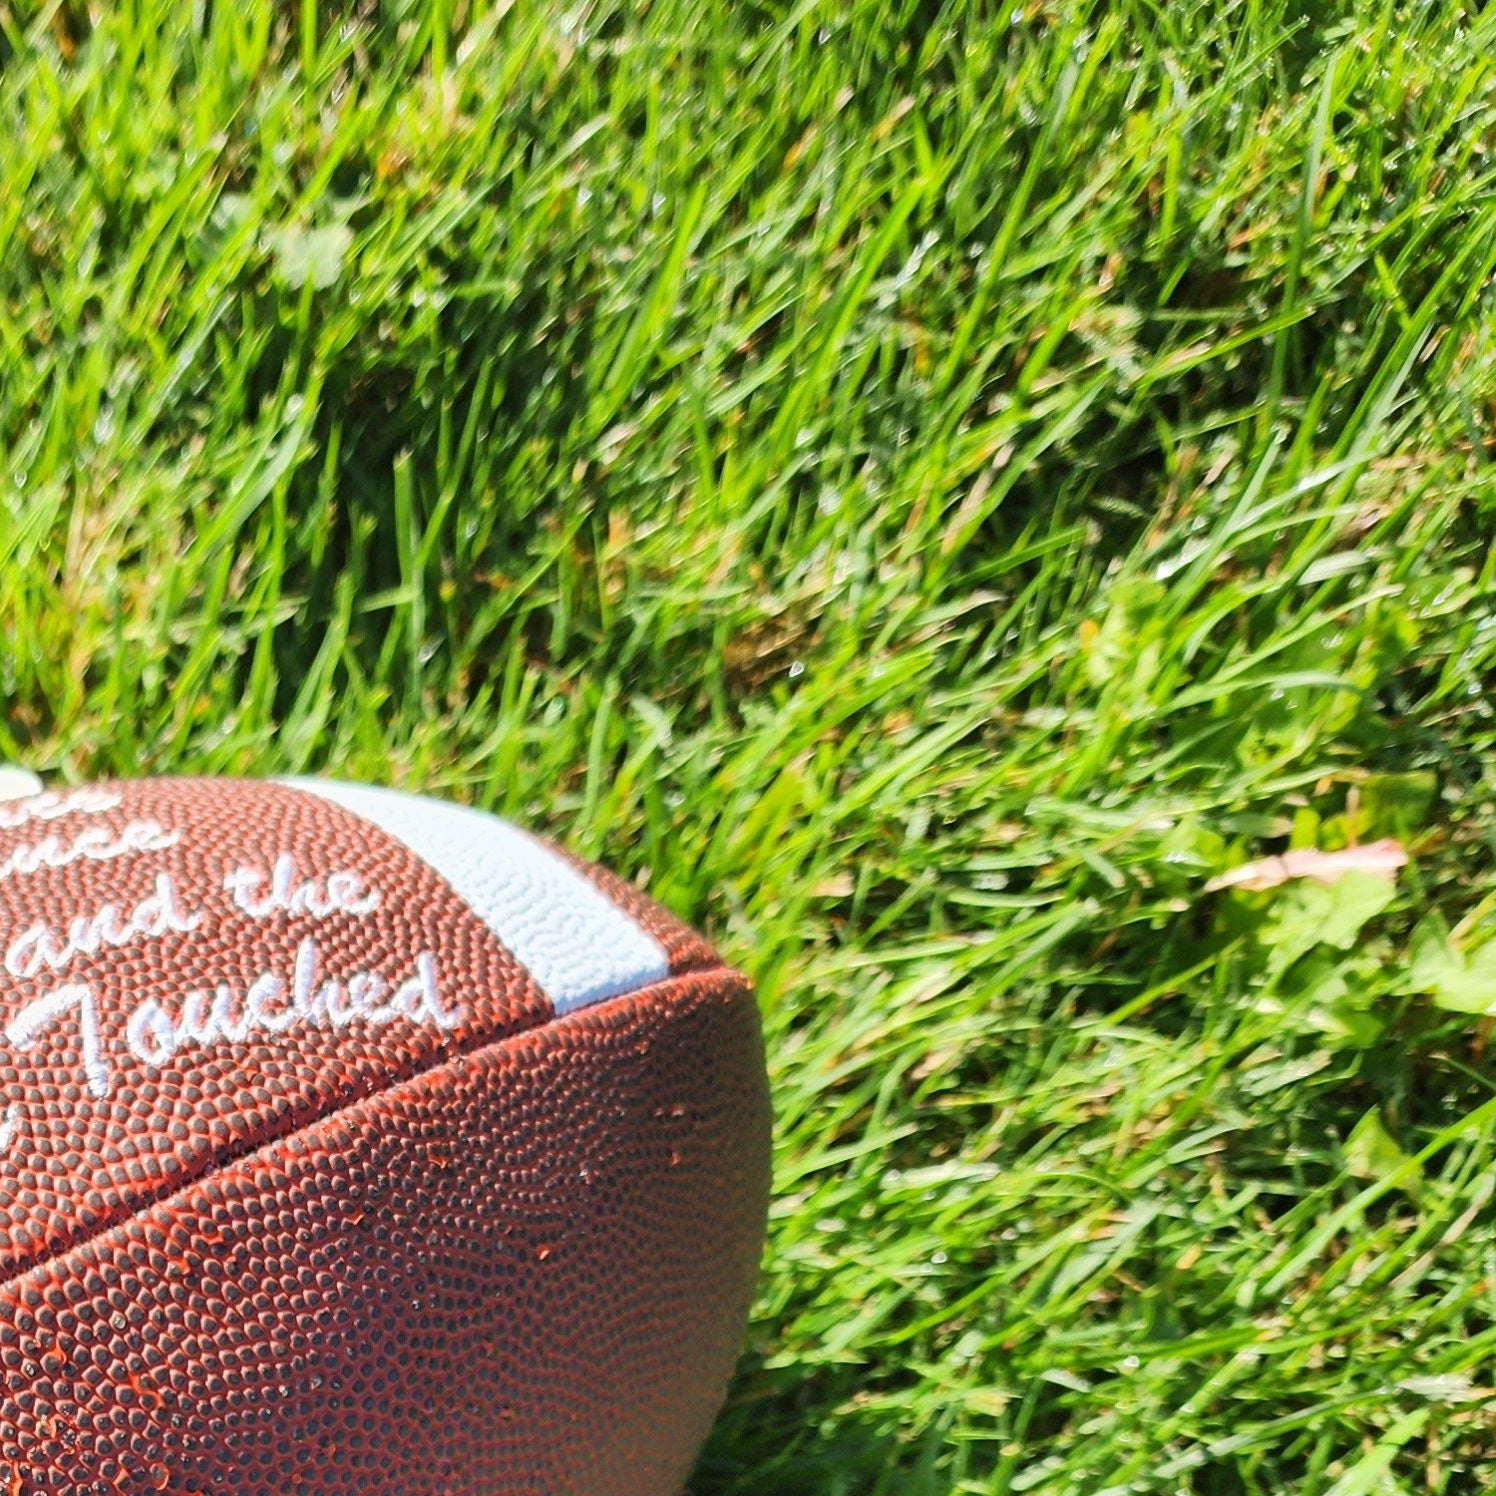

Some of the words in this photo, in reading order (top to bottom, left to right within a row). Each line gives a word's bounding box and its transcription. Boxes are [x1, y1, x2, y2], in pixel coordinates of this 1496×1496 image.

[5, 874, 204, 978] and
[225, 852, 382, 920] the
[5, 937, 459, 1098] Touched
